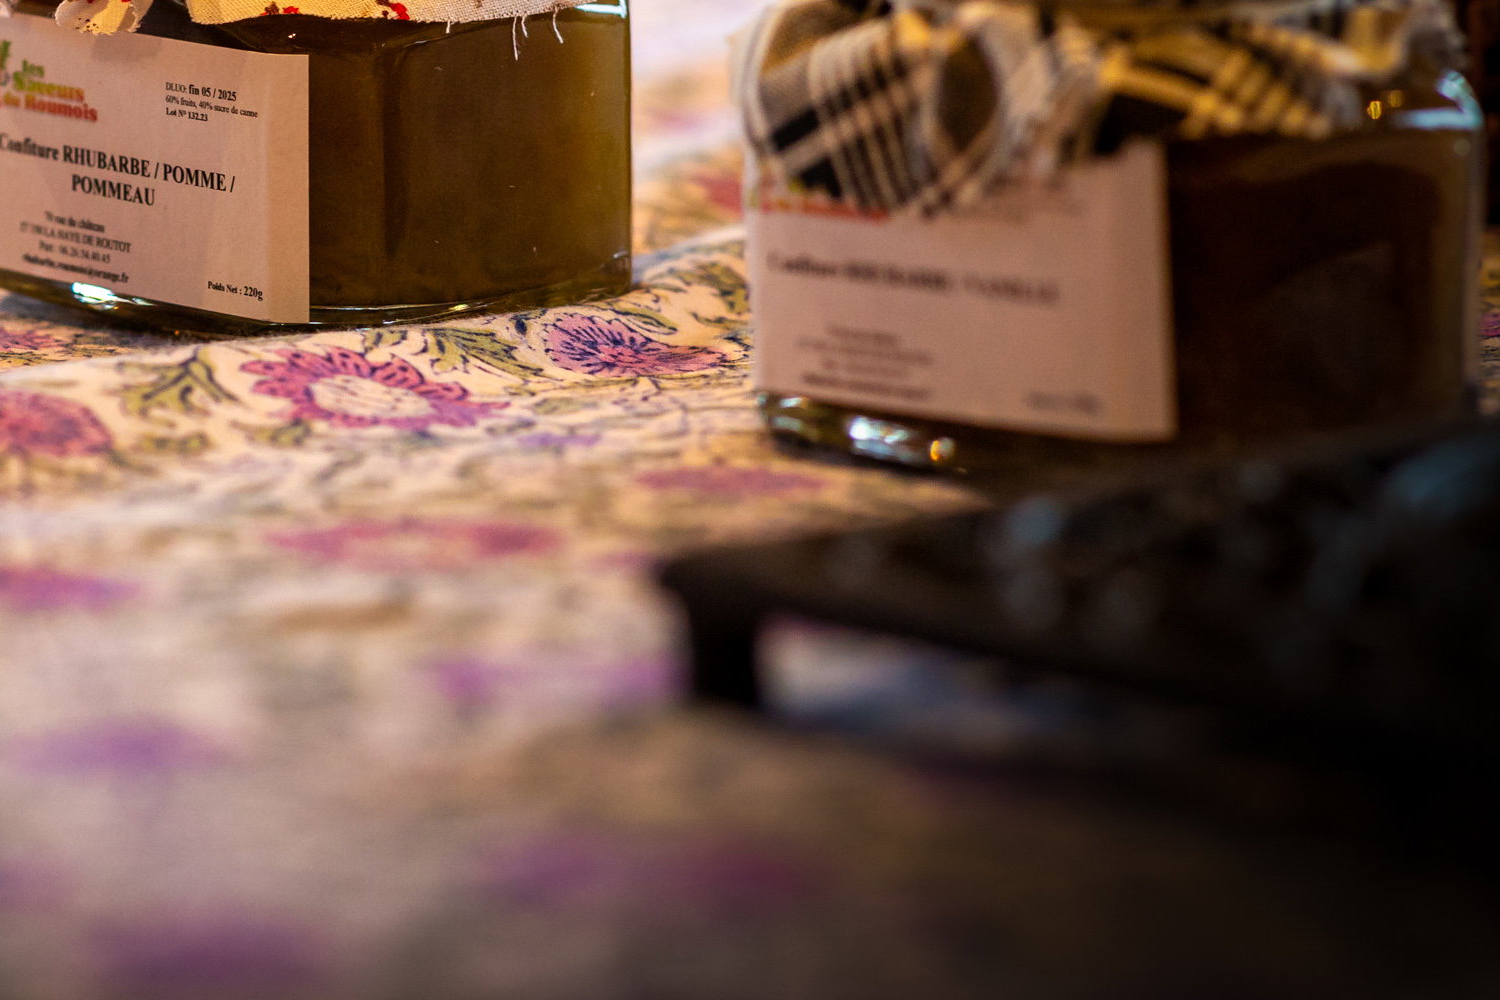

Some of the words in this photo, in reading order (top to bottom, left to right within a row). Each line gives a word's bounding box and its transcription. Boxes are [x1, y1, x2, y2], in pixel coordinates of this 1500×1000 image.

[188, 84, 200, 96] fin
[201, 86, 211, 98] 05
[218, 89, 237, 101] 2025
[24, 93, 98, 122] Roumois
[165, 106, 177, 117] Lot
[198, 100, 213, 111] 40%
[213, 103, 230, 114] sucre
[231, 105, 238, 115] de
[239, 108, 259, 119] canne
[62, 144, 151, 178] RHUBARBE
[153, 162, 160, 180] /
[162, 162, 227, 192] POMME
[229, 175, 236, 193] /
[71, 173, 155, 207] POMMEAU
[207, 280, 225, 292] Poids
[226, 284, 238, 294] Net
[243, 285, 263, 302] 220g
